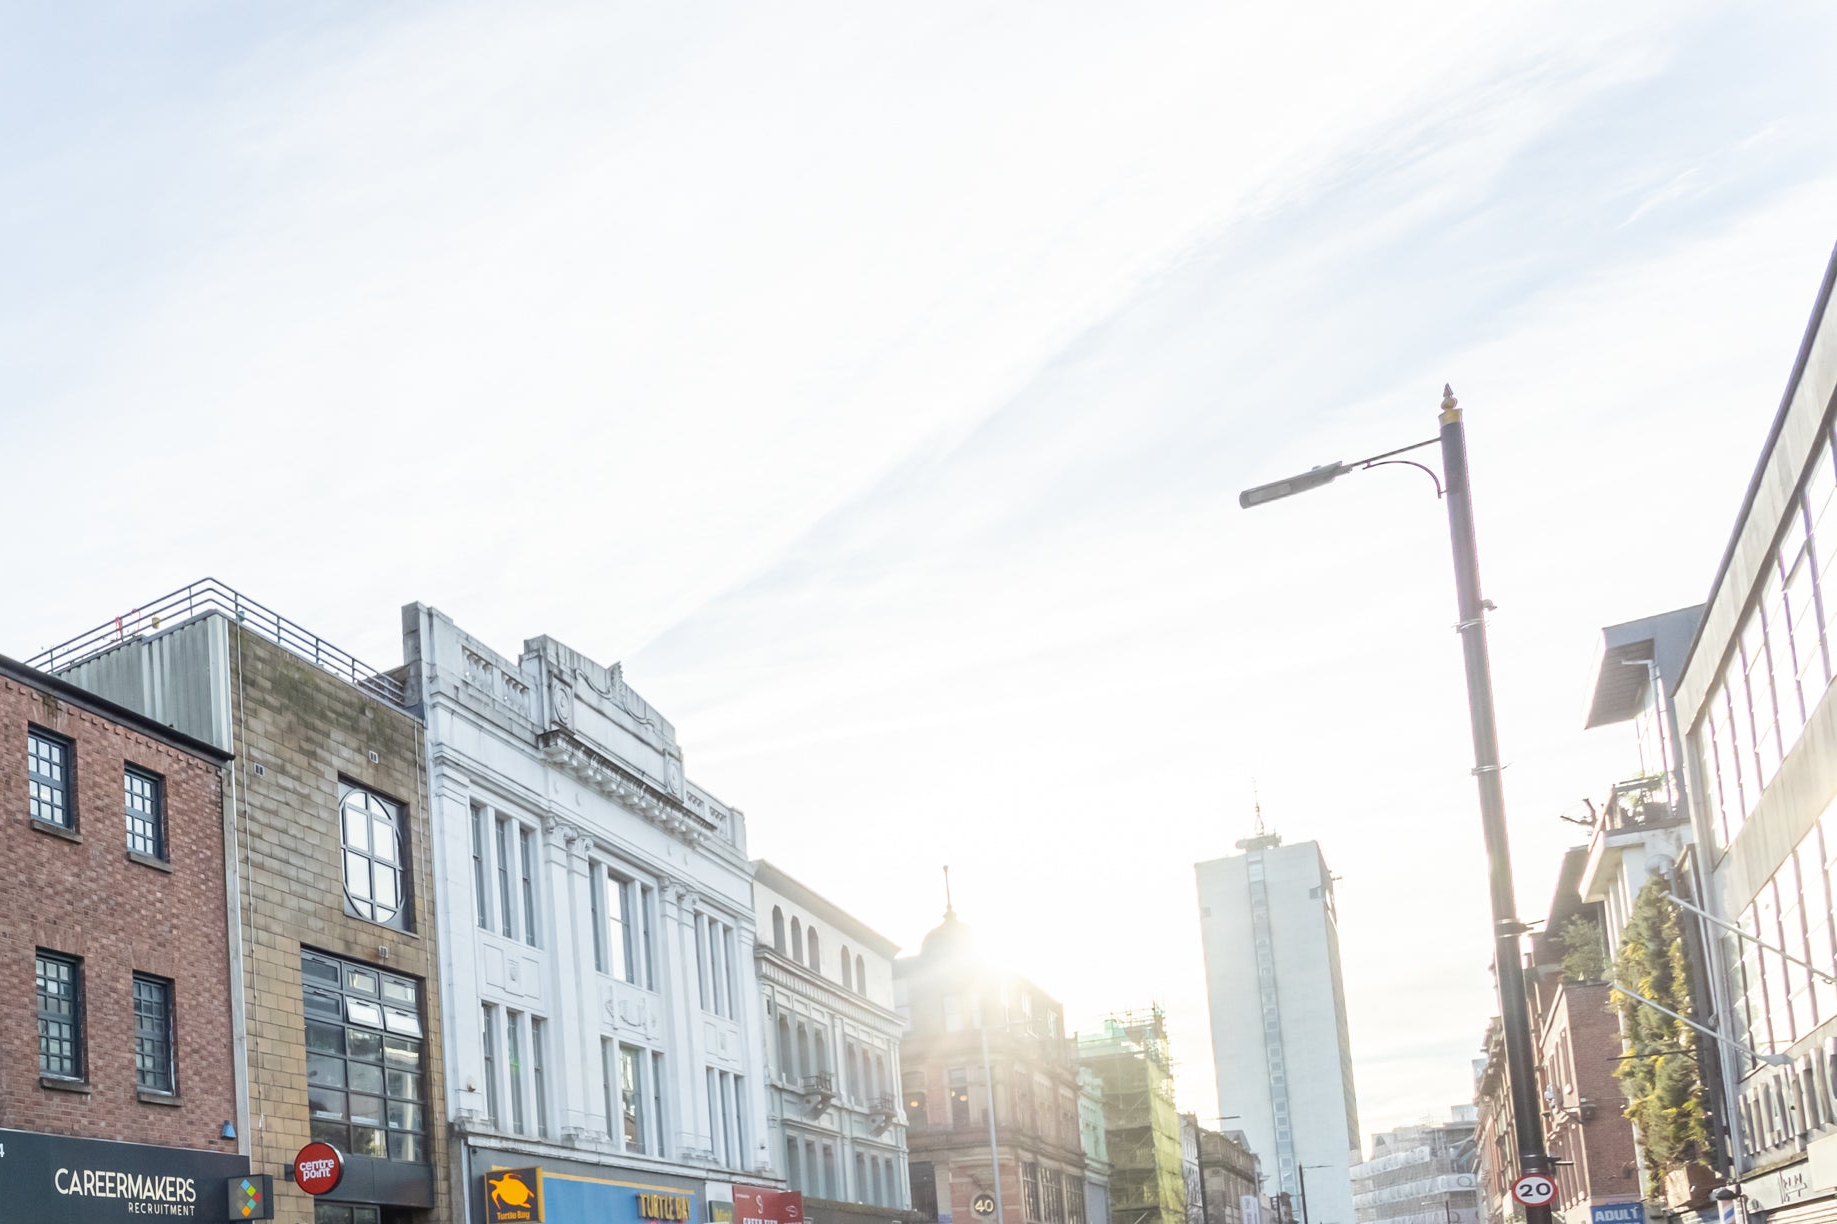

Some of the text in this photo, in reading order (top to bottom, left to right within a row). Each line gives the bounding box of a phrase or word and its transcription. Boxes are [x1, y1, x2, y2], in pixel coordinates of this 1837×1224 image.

[299, 1159, 335, 1172] centre
[303, 1168, 331, 1182] point
[54, 1168, 197, 1203] CAREERMAKERS
[1519, 1182, 1551, 1197] 20
[128, 1202, 196, 1216] RECRUITMENT
[637, 1193, 675, 1220] TURTLE
[675, 1194, 691, 1221] BAY
[974, 1199, 994, 1213] 40
[497, 1211, 531, 1221] Turtle Bay
[1595, 1209, 1639, 1222] ADULT
